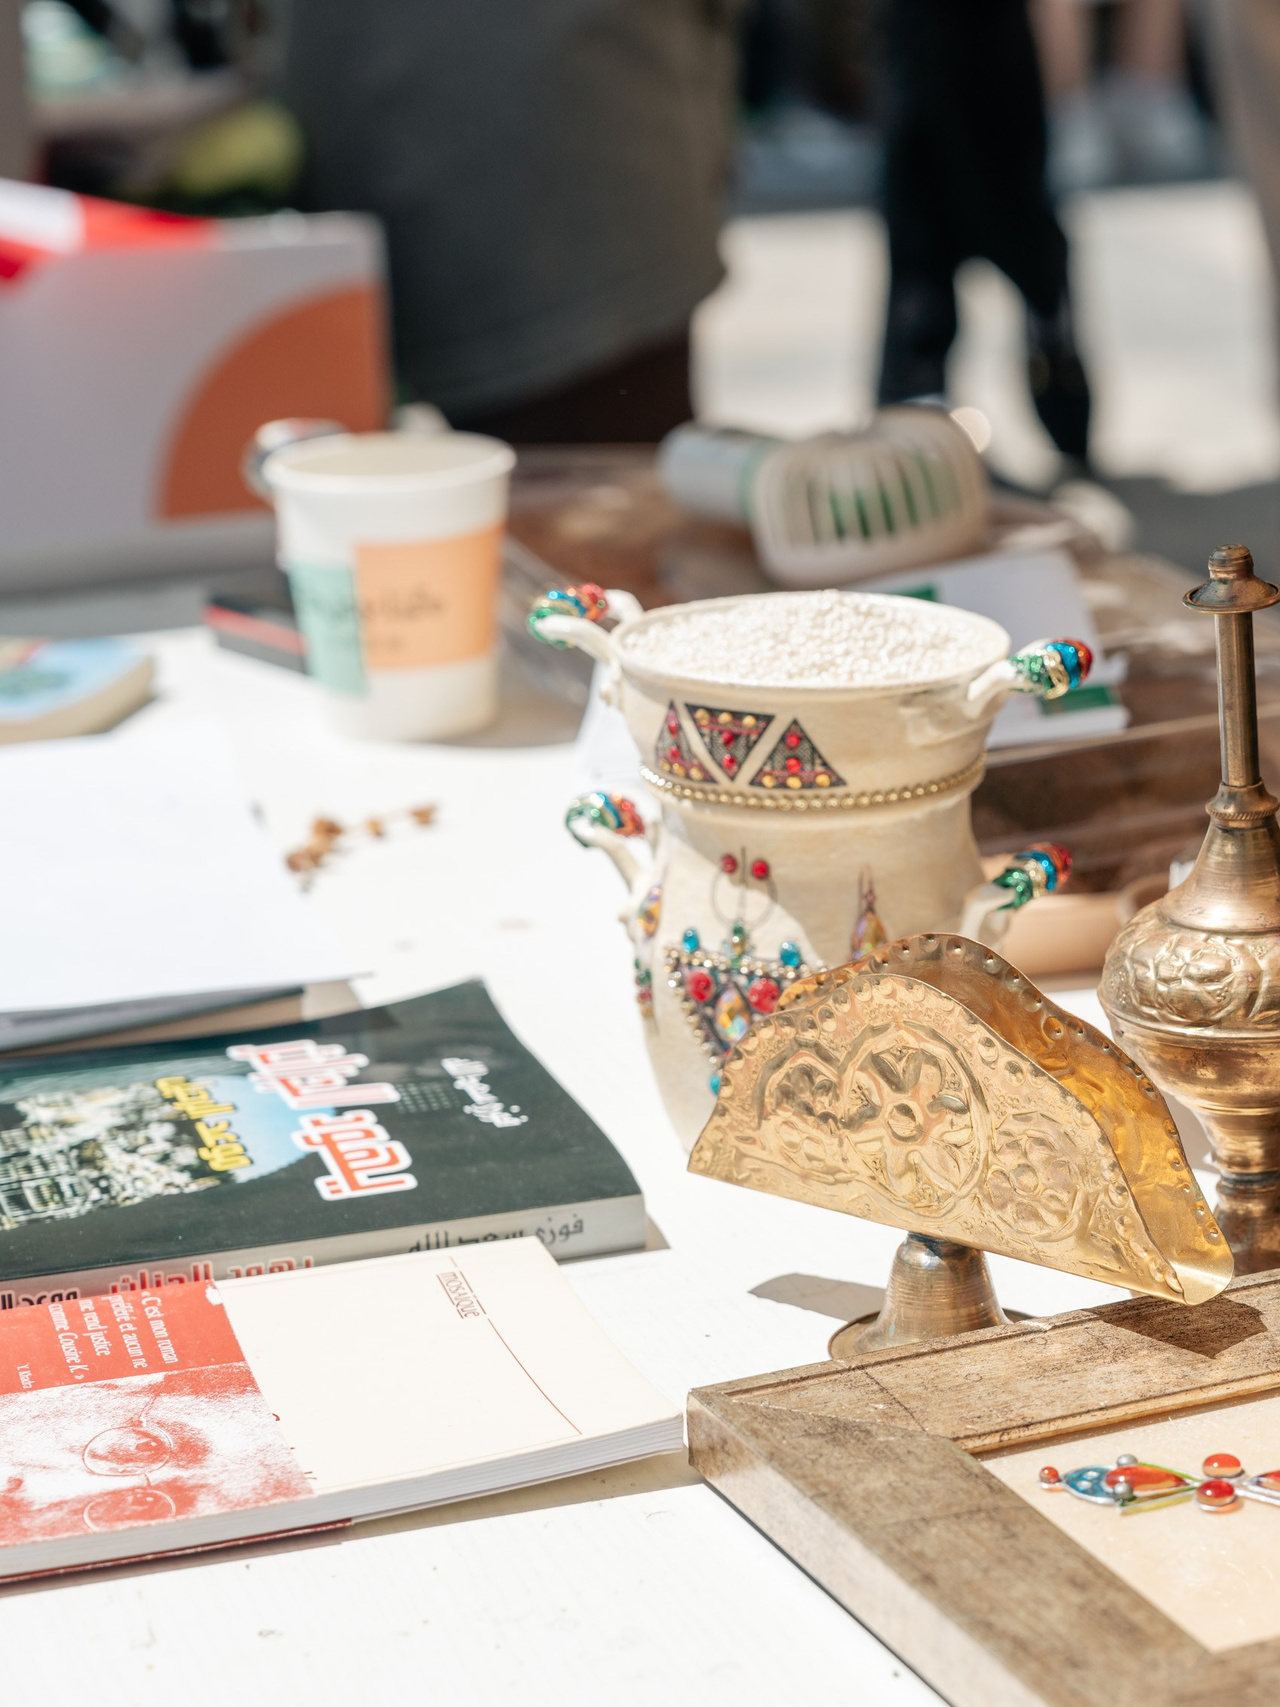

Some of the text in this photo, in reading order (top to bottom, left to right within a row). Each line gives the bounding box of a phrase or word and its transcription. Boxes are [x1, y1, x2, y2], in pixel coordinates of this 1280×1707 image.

[293, 1110, 417, 1200] يهود
[48, 1303, 70, 1331] comme
[78, 1299, 111, 1356] me rend justice
[101, 1294, 148, 1369] préféré et aucun ne
[149, 1319, 168, 1339] mon
[58, 1331, 83, 1363] Cousine
[157, 1338, 178, 1364] roman
